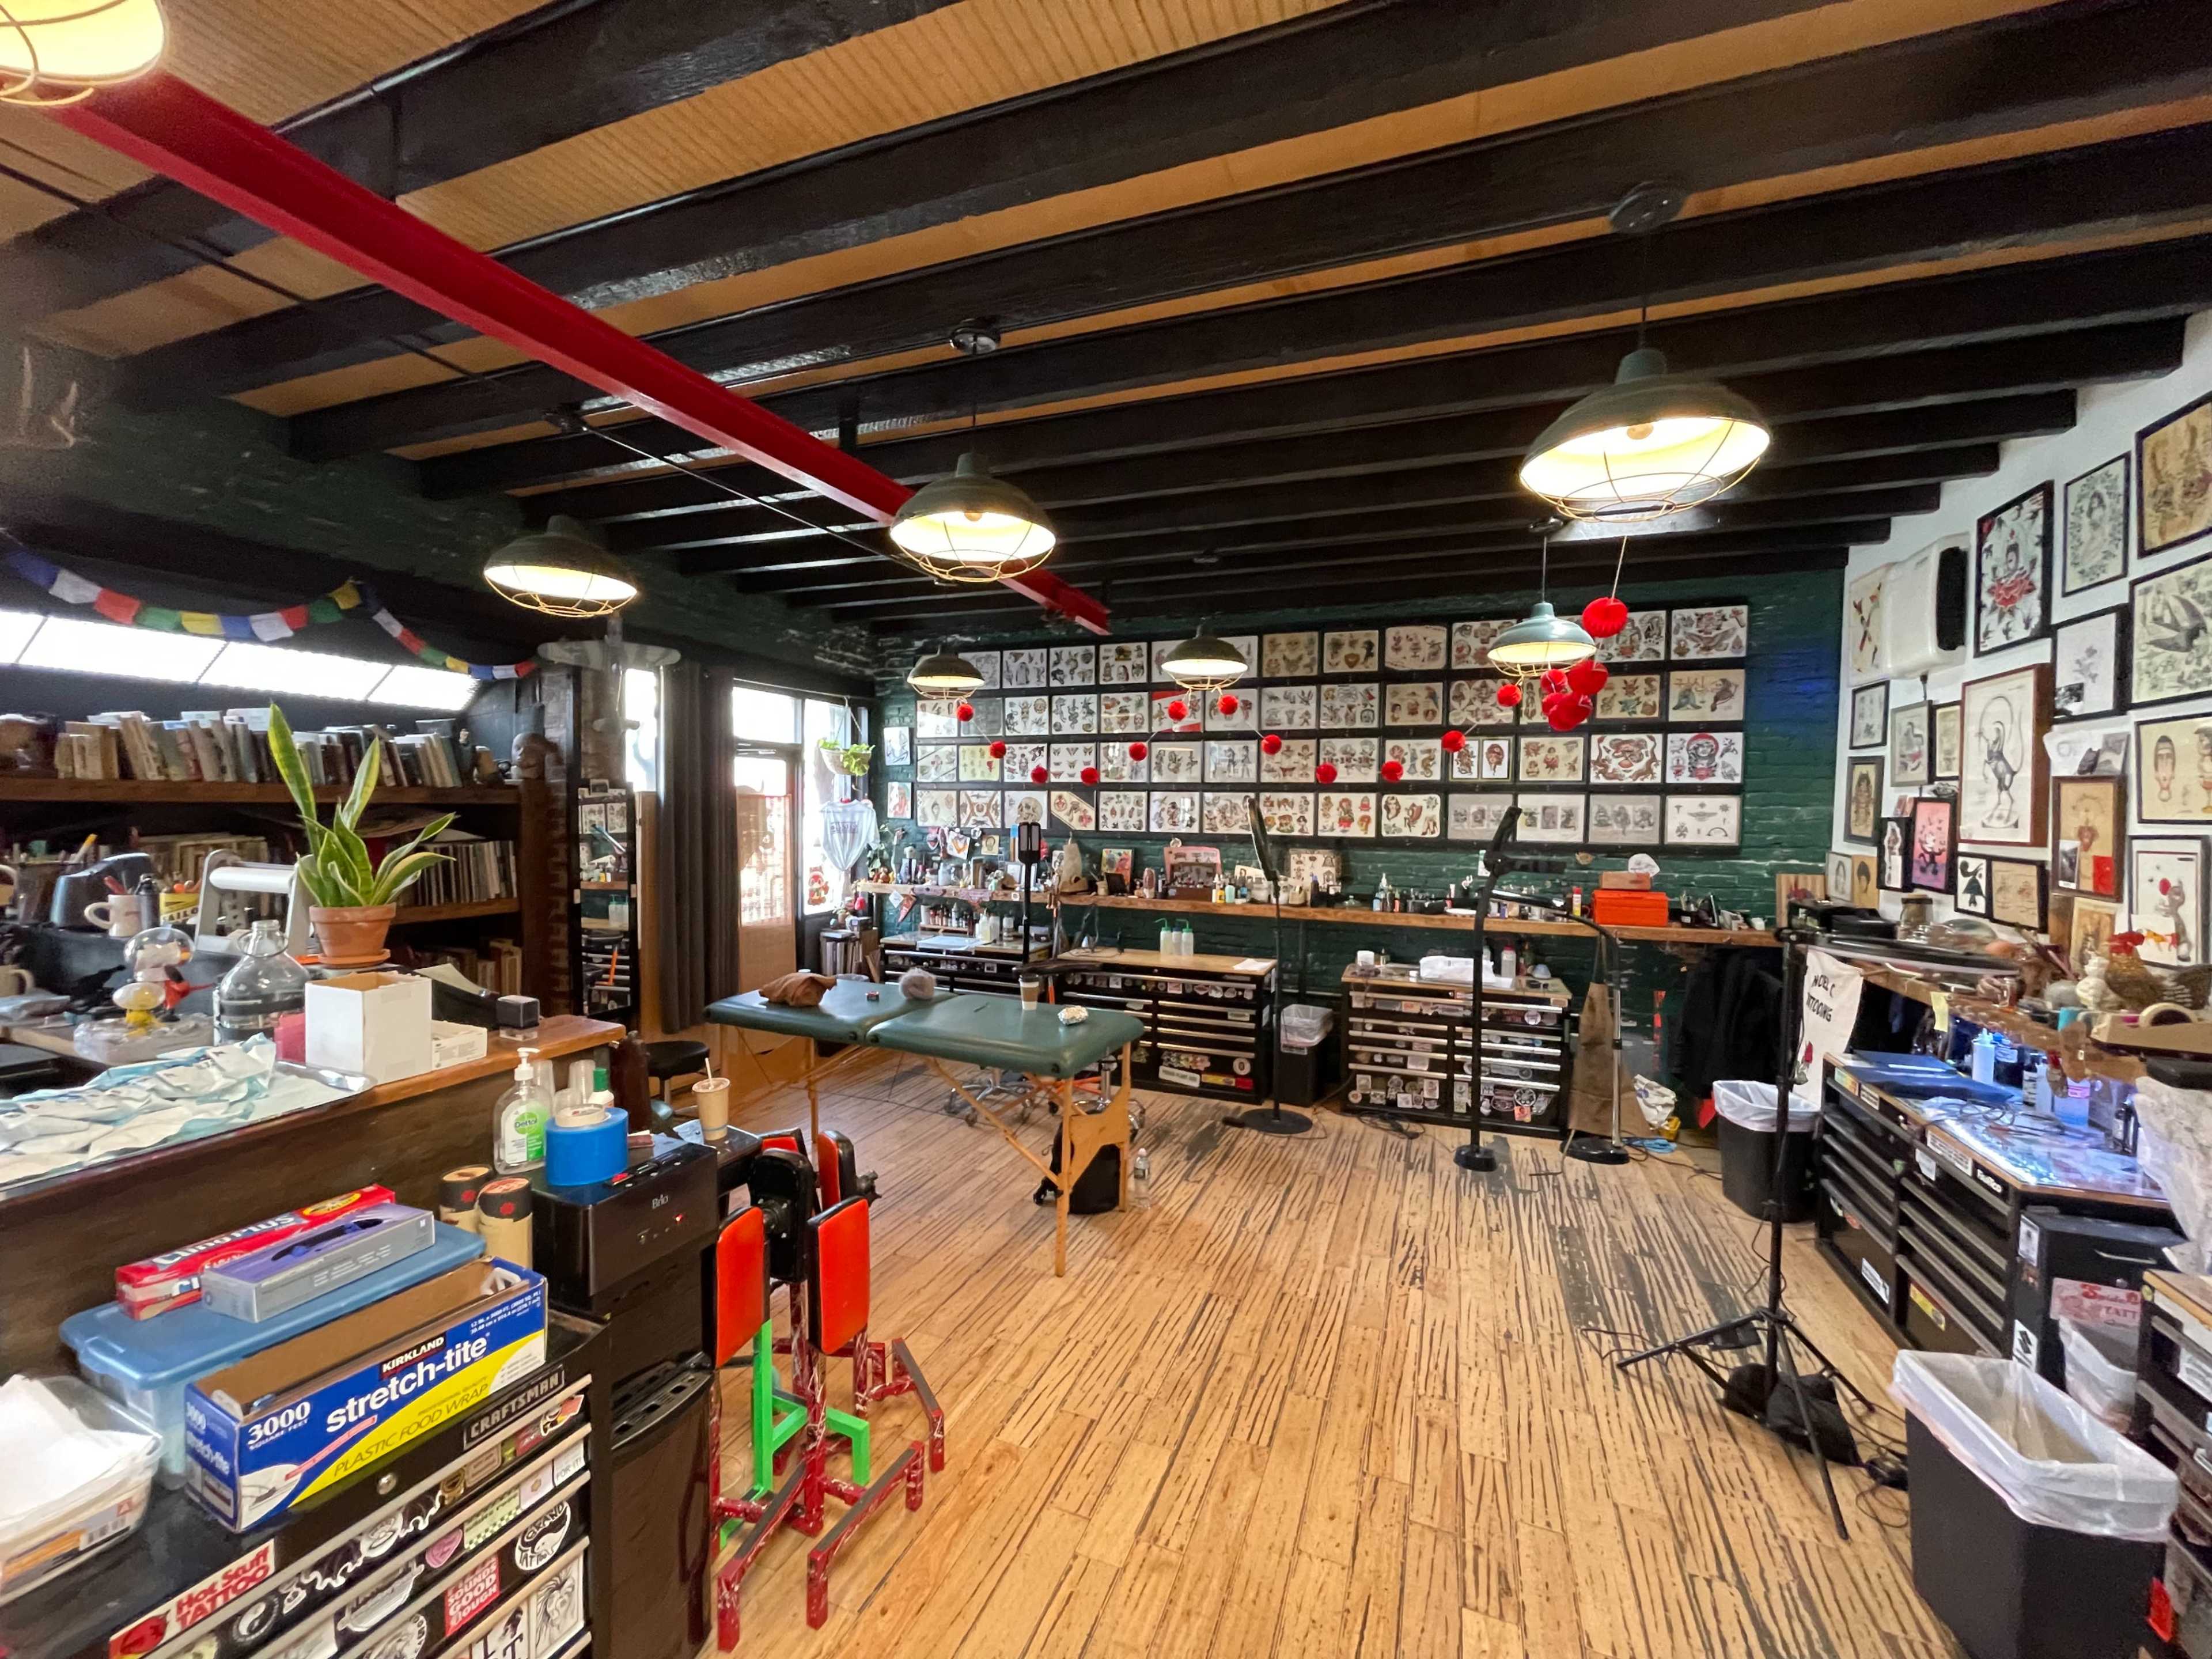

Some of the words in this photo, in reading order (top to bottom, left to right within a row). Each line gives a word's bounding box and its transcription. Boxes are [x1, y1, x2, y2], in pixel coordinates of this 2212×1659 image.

[514, 1118, 537, 1128] Dettol
[381, 1336, 445, 1373] KIRKLAND
[326, 1339, 487, 1433] stretch-tite
[469, 1373, 560, 1439] CRAFTSMAN
[247, 1401, 311, 1446] 3000
[334, 1433, 397, 1477] PLASTIC
[399, 1411, 442, 1440] FOOD
[446, 1384, 489, 1415] WRAP
[176, 1564, 271, 1629] TATTOO
[448, 1562, 498, 1605] SOUNDS
[449, 1573, 497, 1616] GOOD
